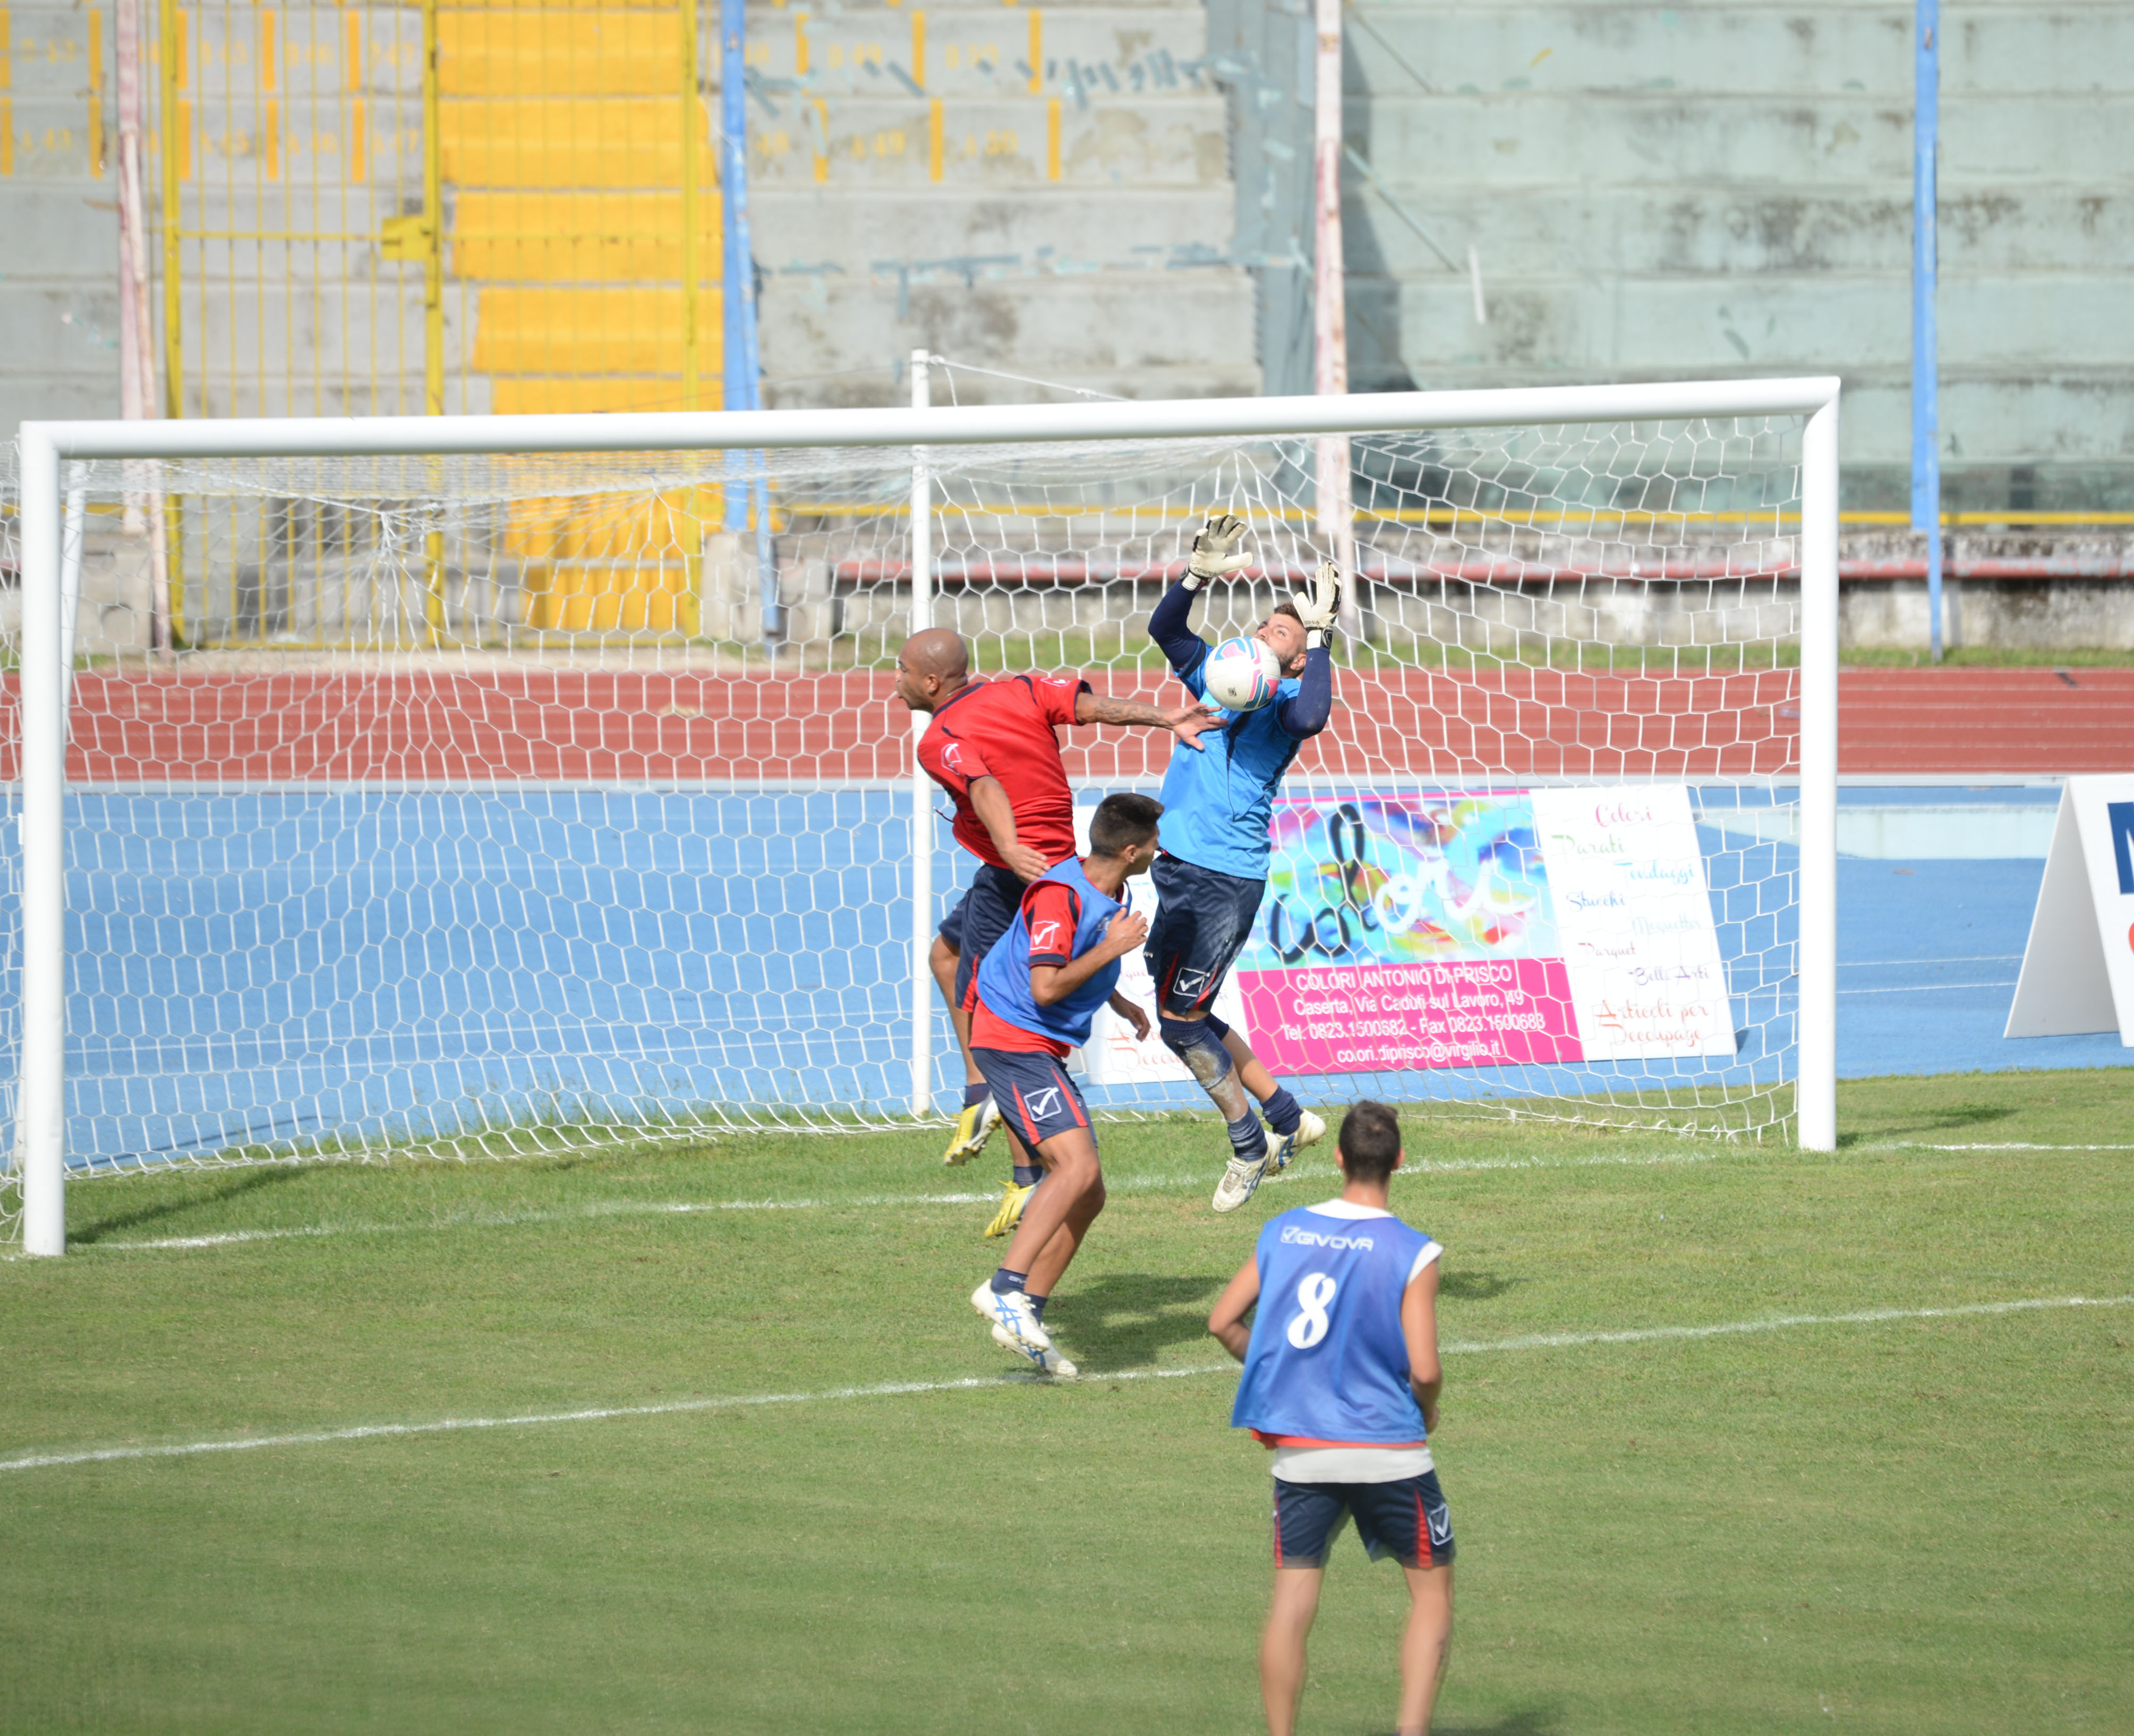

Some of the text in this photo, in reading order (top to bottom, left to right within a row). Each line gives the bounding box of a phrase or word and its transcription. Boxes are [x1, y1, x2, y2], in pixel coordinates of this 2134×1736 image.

[872, 128, 907, 157] 49
[1295, 971, 1356, 991] COLORI
[1363, 970, 1432, 988] ANTONIO
[1453, 965, 1513, 984] PRISCO
[1293, 998, 1353, 1015] Caserta,
[1354, 996, 1379, 1013] Via
[1429, 992, 1450, 1009] sul
[1452, 992, 1505, 1008] Lavoro,
[1506, 990, 1525, 1006] 49
[1681, 1005, 1709, 1023] per
[1281, 1023, 1306, 1041] Tel.
[1419, 1017, 1446, 1034] Fax
[1296, 1230, 1375, 1252] GIVOVA
[1287, 1272, 1337, 1349] 8
